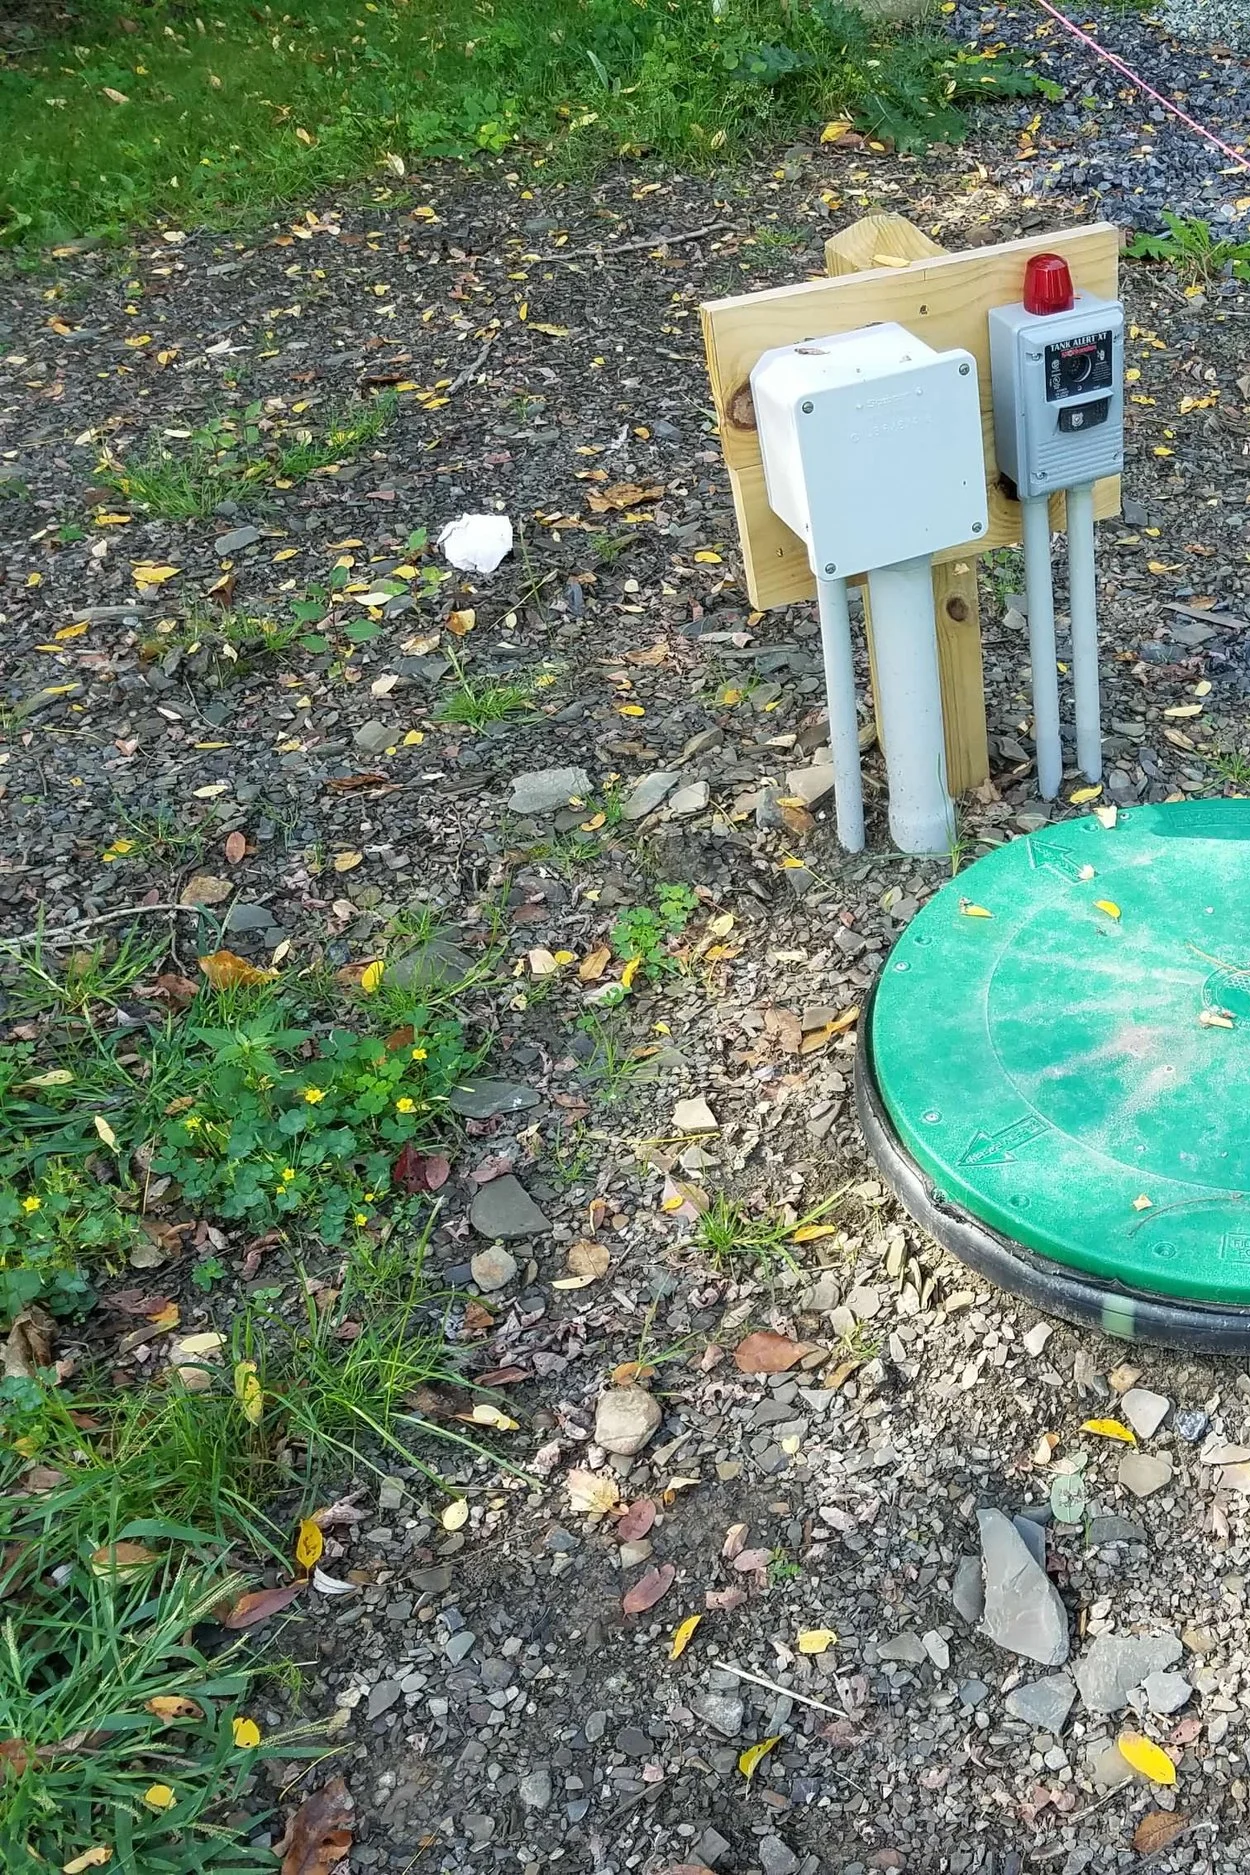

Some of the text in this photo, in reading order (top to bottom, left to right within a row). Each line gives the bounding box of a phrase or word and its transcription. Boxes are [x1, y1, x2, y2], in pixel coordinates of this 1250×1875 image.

[1050, 343, 1071, 352] TANK
[1072, 335, 1098, 347] ALERT
[1098, 332, 1107, 341] XT
